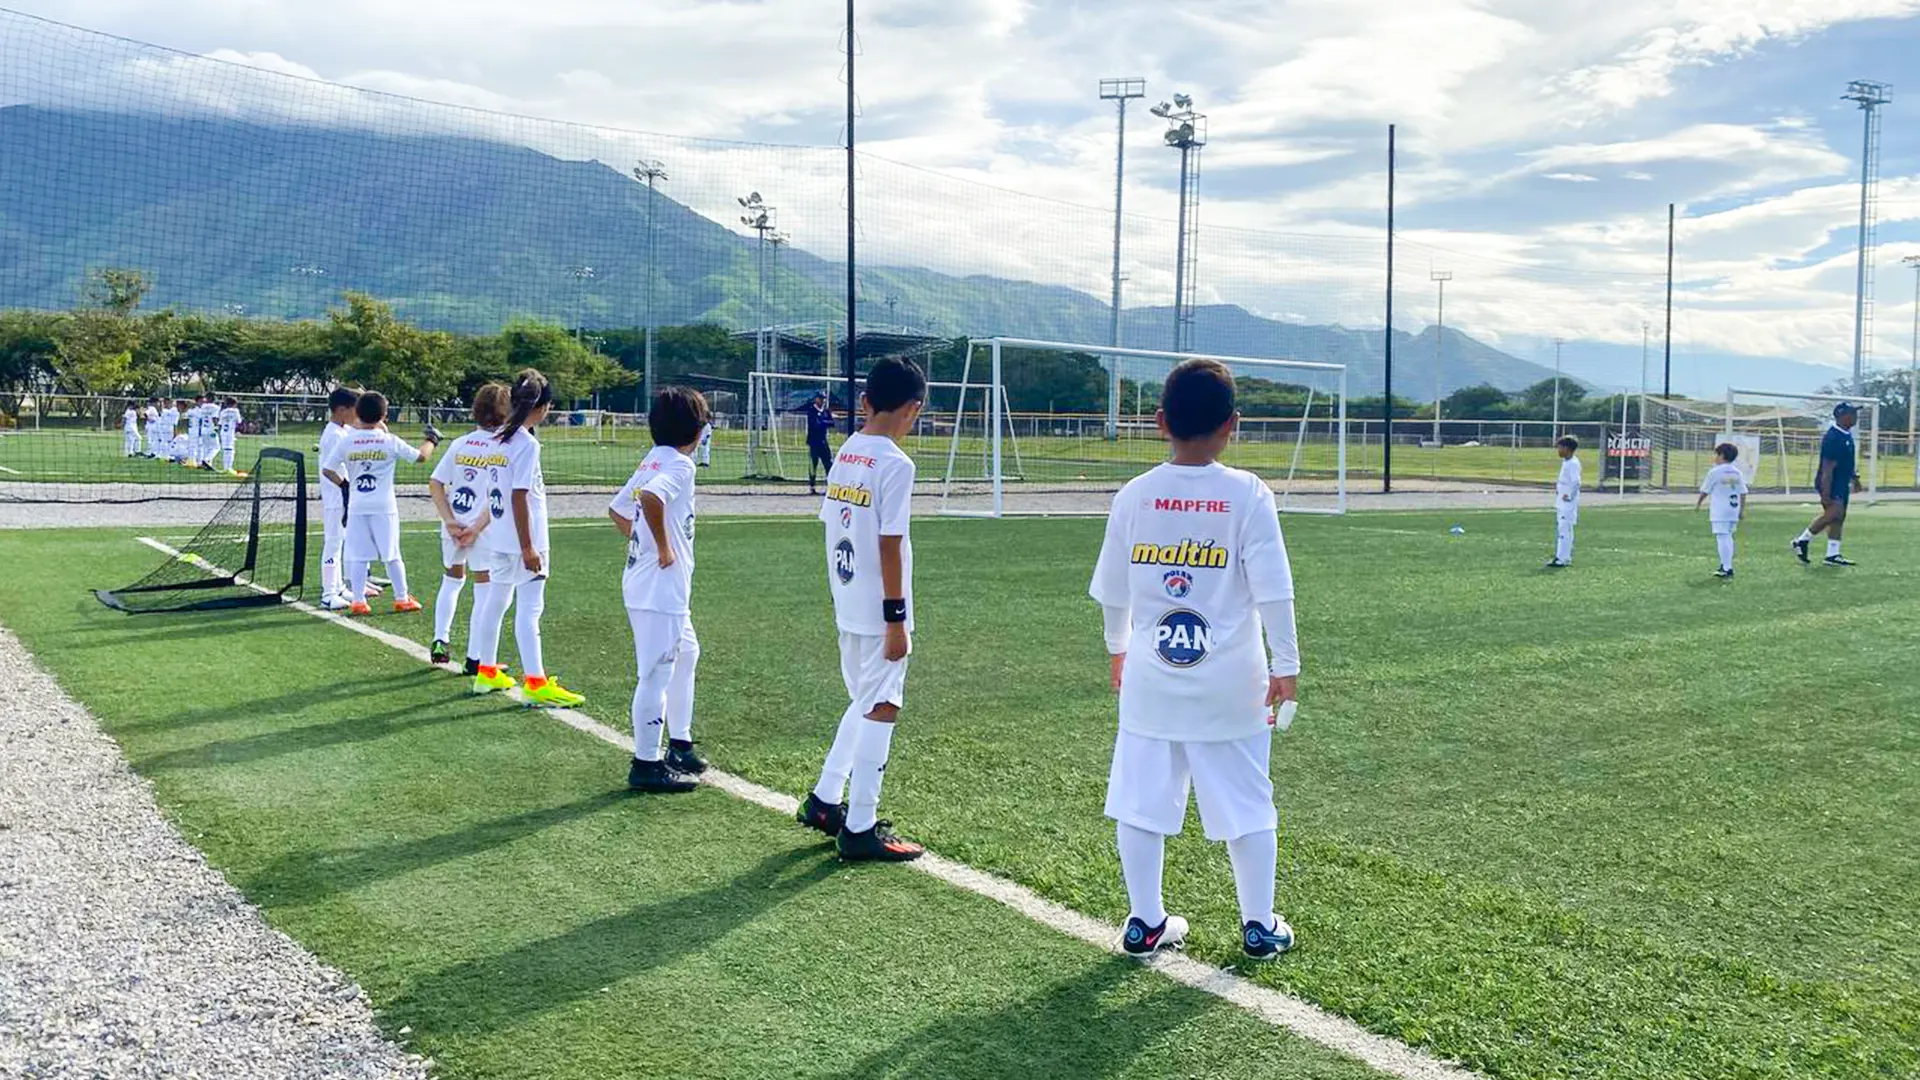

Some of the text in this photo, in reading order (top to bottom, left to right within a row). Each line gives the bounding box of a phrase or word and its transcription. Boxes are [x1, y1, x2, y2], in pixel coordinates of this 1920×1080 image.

[839, 453, 877, 469] MAPFRE
[1155, 498, 1231, 513] MAPFRE
[1131, 538, 1229, 569] maltín
